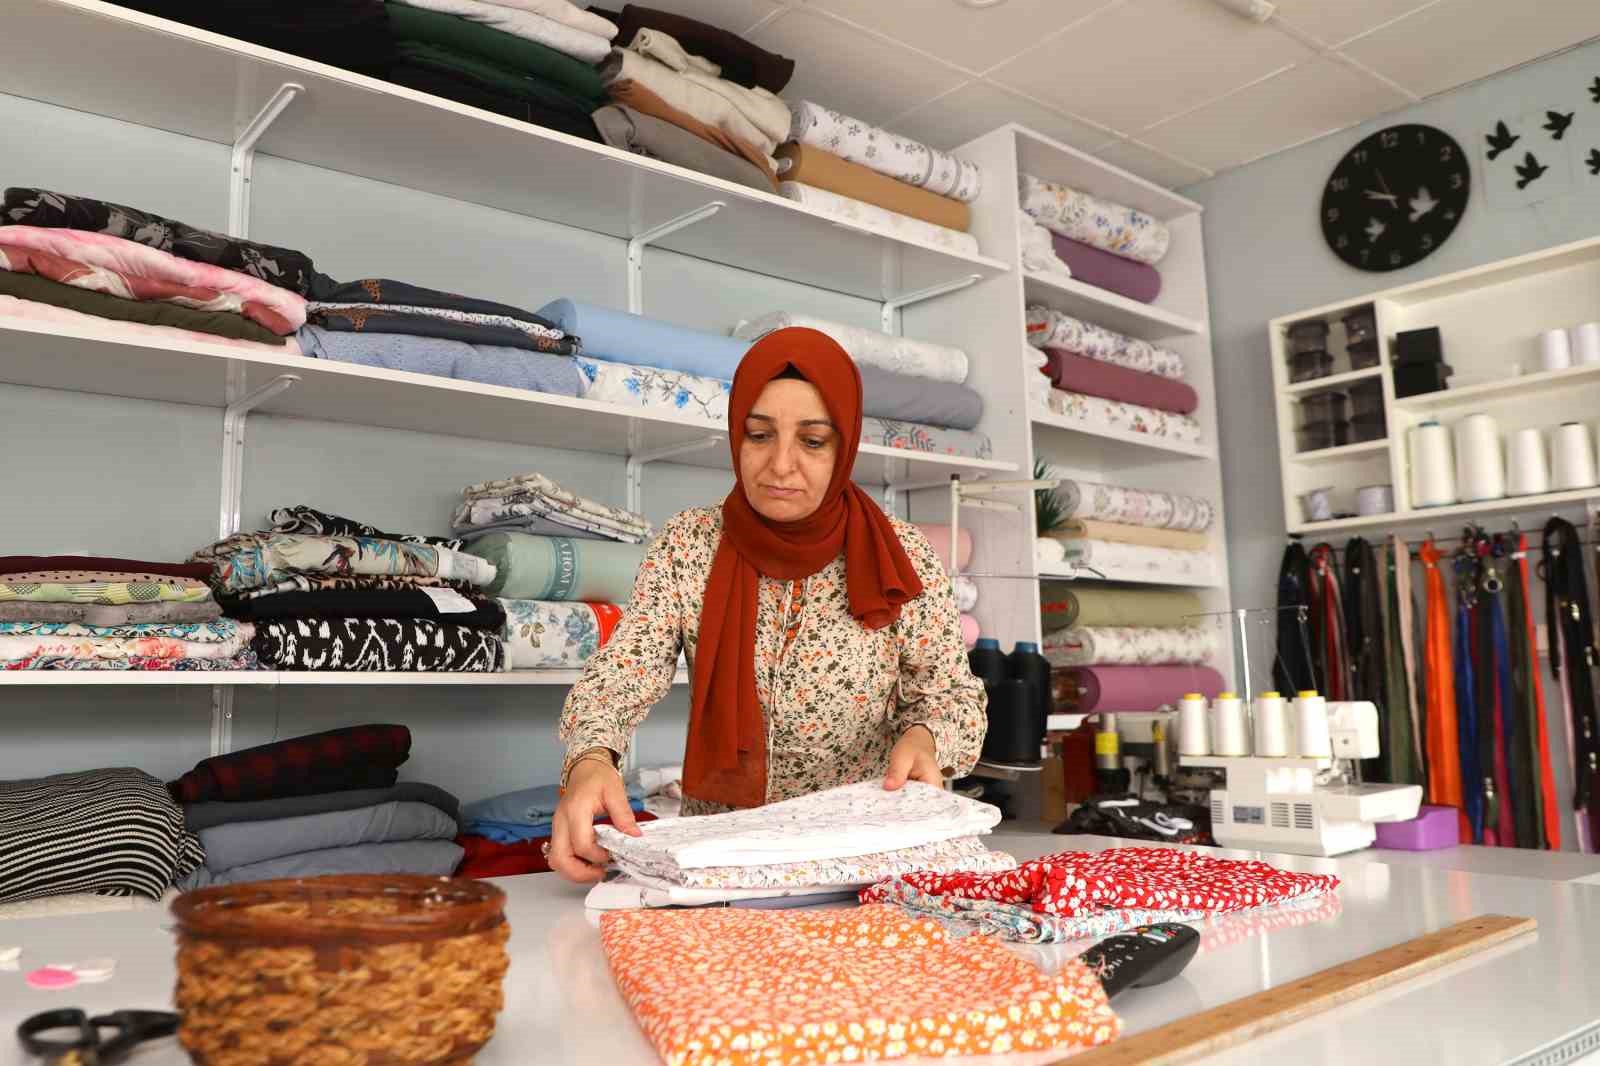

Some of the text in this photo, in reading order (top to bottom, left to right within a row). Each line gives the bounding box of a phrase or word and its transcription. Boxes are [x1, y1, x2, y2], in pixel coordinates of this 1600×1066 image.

[1381, 131, 1399, 148] 12
[1417, 131, 1425, 144] 1
[1440, 146, 1451, 162] 2
[1450, 173, 1462, 189] 3
